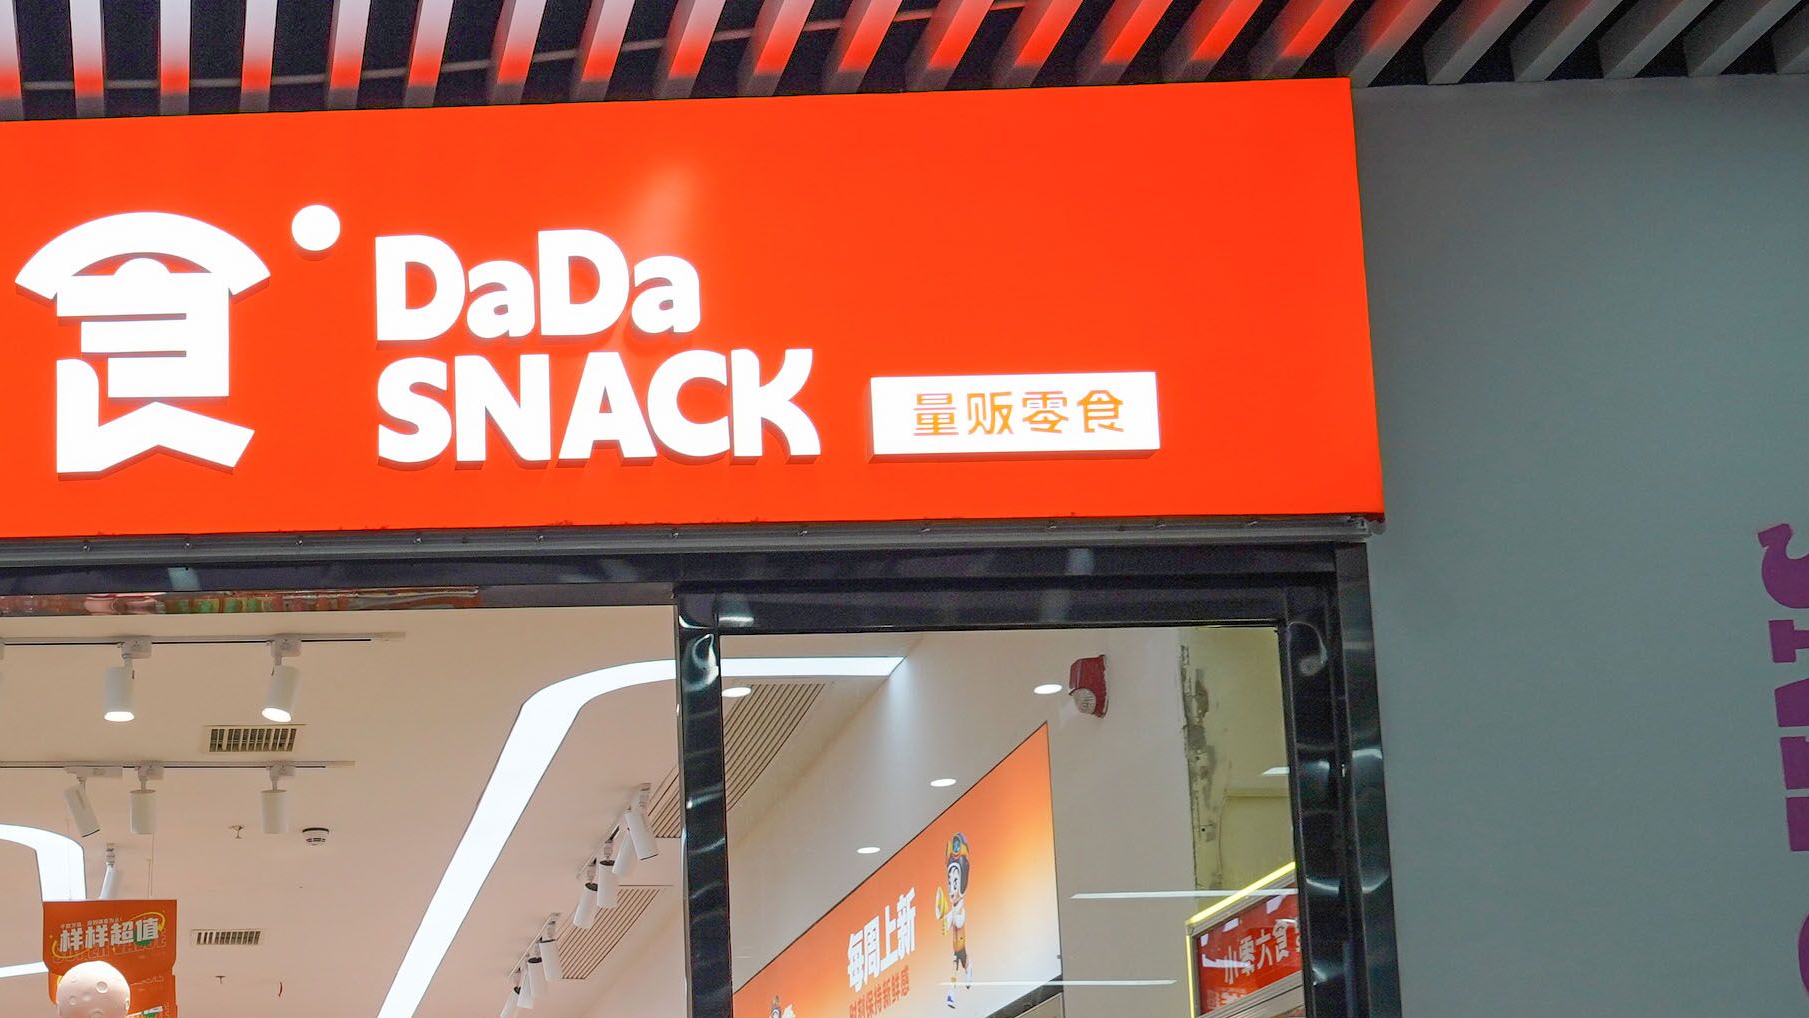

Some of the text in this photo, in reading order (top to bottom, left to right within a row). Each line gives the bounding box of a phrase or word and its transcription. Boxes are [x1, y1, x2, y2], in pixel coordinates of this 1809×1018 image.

[375, 228, 701, 346] DaDa
[377, 347, 822, 468] SNACK
[911, 389, 1126, 437] 量贩零食
[59, 917, 159, 952] 样样超值
[847, 887, 916, 993] 每周上新
